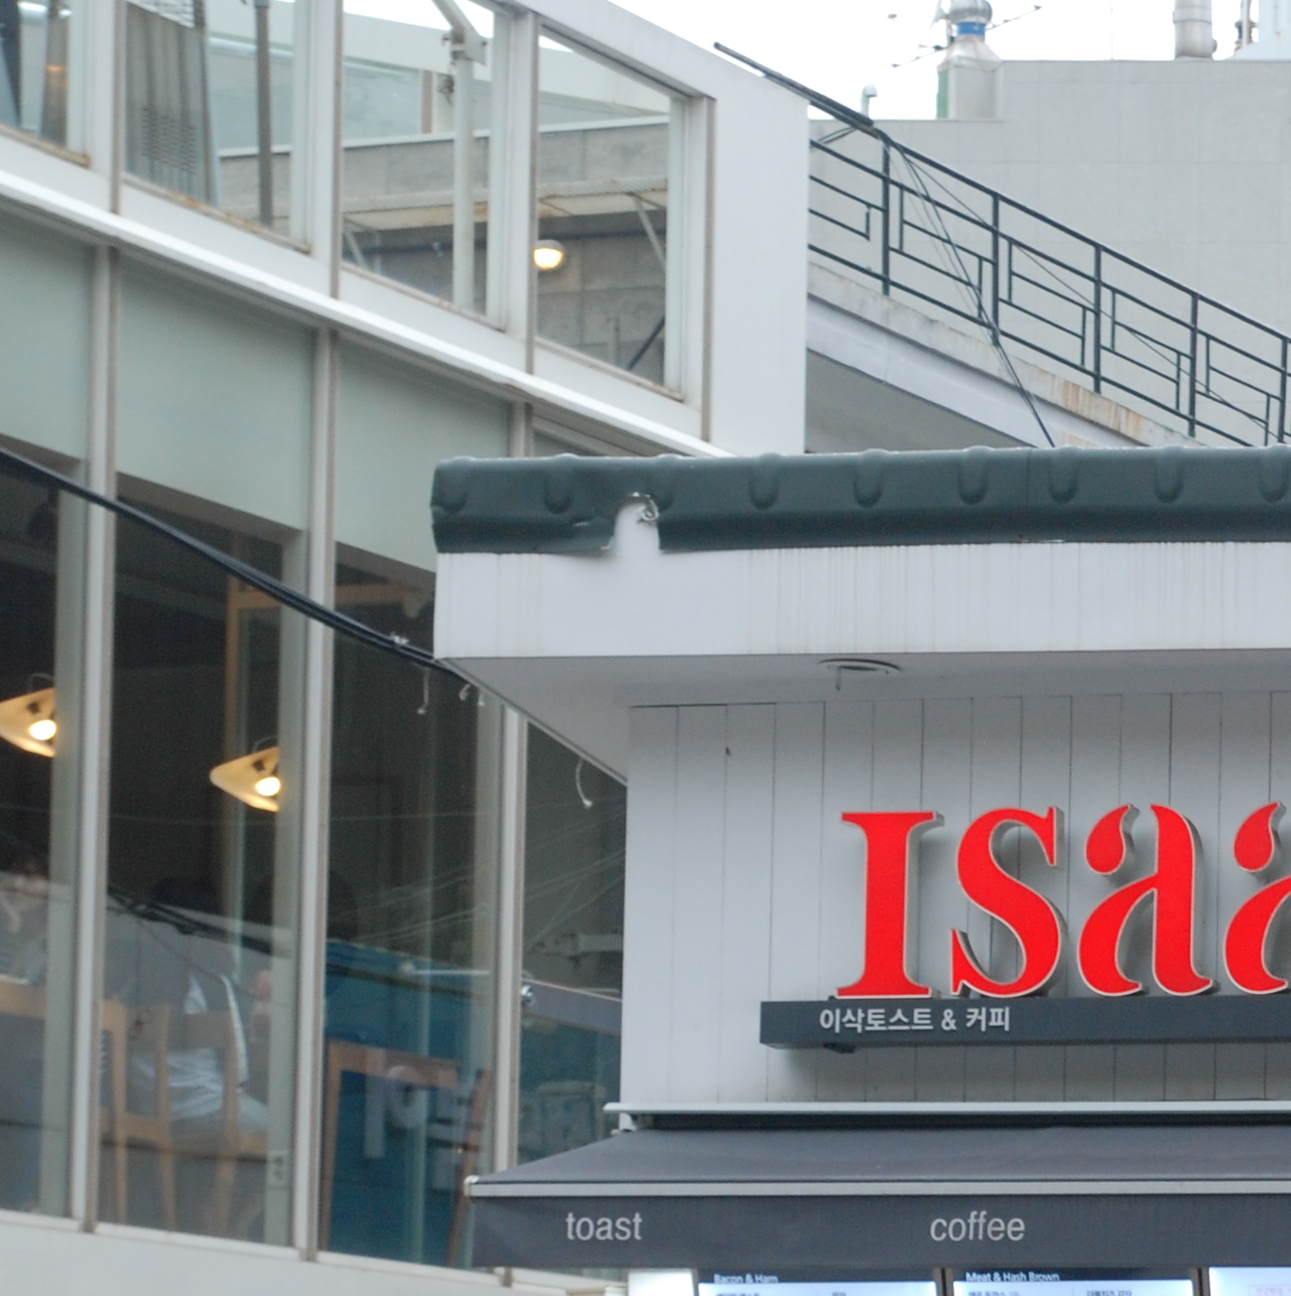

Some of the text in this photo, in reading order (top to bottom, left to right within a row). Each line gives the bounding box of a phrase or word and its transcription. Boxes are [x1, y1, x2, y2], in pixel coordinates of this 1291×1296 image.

[819, 1005, 1011, 1032] 이삭토스트 & 커피
[566, 1211, 643, 1241] toast
[929, 1210, 1027, 1242] coffee
[714, 1273, 743, 1284] Bacon
[755, 1273, 778, 1284] Ham
[966, 1272, 991, 1282] Meat
[1003, 1272, 1027, 1282] Hash
[1029, 1272, 1060, 1282] Brown
